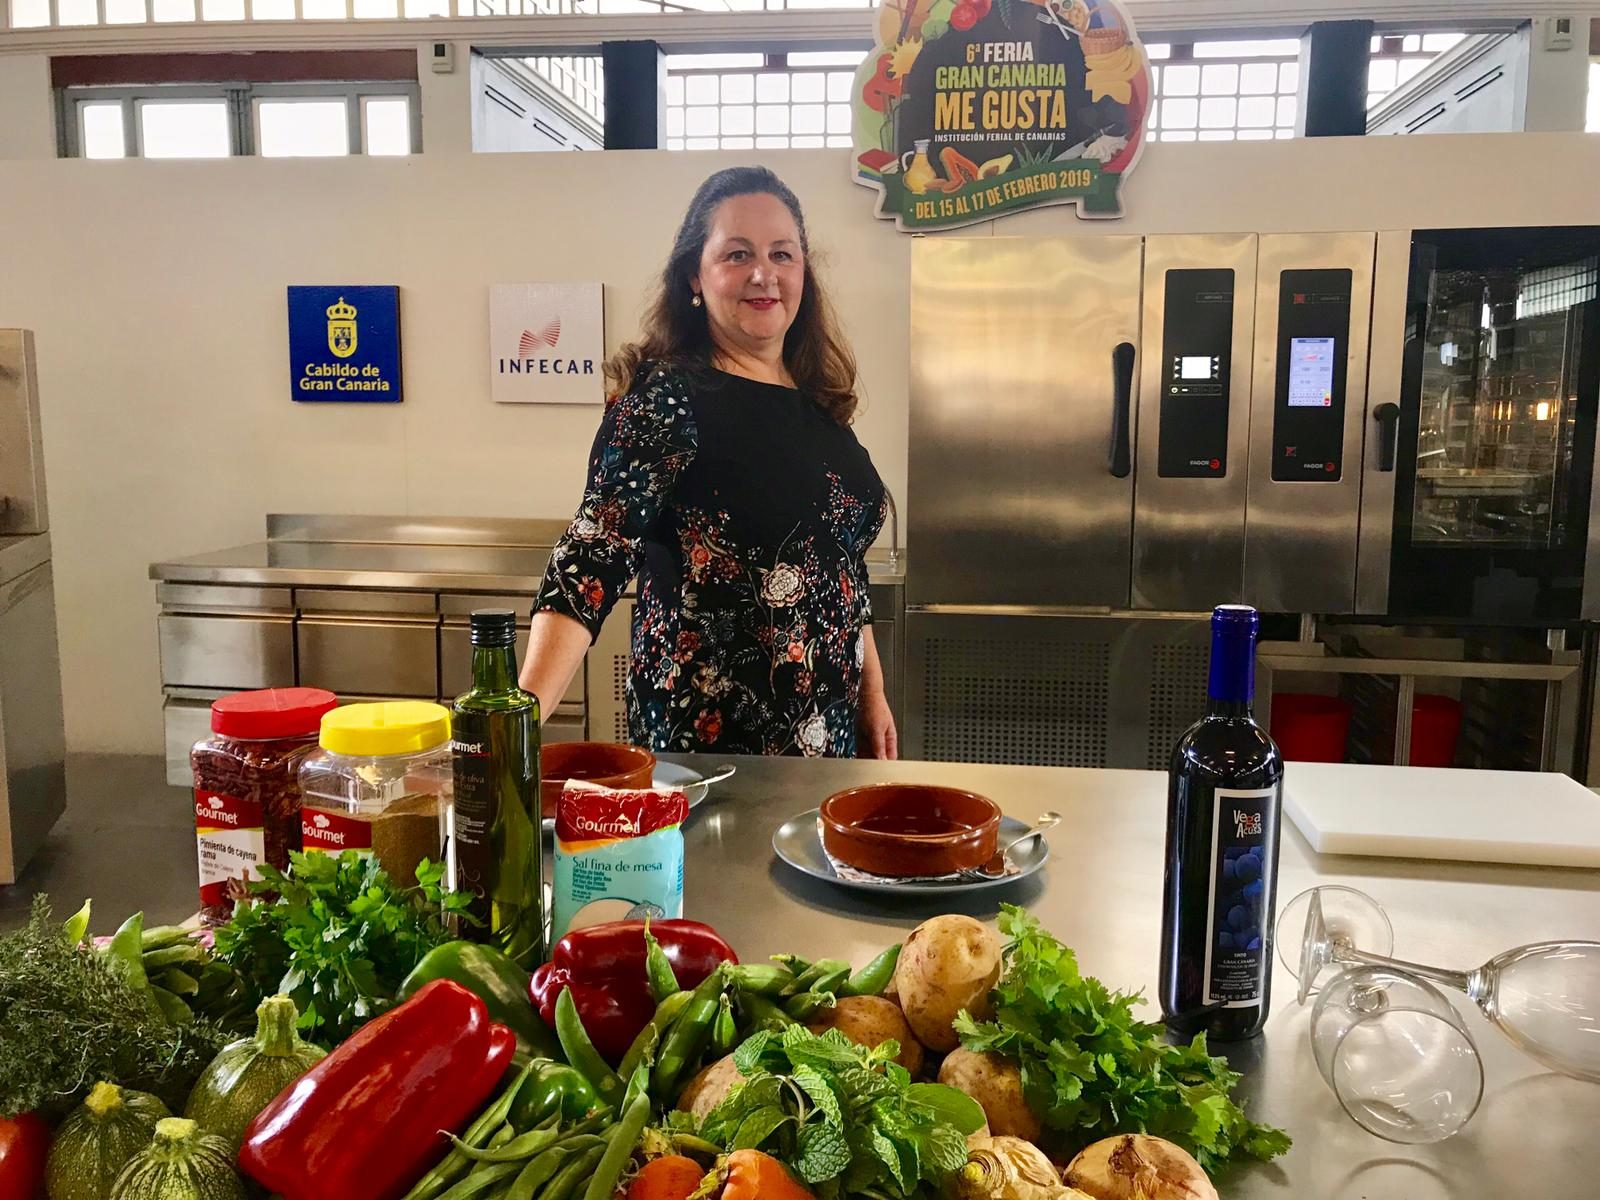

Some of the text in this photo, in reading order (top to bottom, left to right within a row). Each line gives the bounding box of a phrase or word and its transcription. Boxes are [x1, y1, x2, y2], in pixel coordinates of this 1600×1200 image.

[983, 42, 1034, 62] FERIA
[936, 64, 1067, 89] GRAN CANARIA
[934, 89, 1067, 130] ME GUSTA
[934, 132, 1066, 142] INSTITUCIÓN FERIAL DE CANARIAS
[915, 169, 1091, 219] DEL 15 AL 17 DE FEBRERO 2019
[305, 363, 380, 377] Cabildo de
[500, 359, 594, 374] INFECAR
[300, 378, 390, 392] Gran Canaria
[196, 802, 238, 825] Gourmet
[1233, 810, 1261, 828] Vega
[302, 821, 344, 844] Gourmet
[576, 815, 640, 835] Gourmet
[1236, 823, 1262, 838] Acusa
[200, 838, 257, 861] Pimienta de cayena
[200, 850, 217, 860] rama
[572, 856, 588, 869] Sal
[591, 858, 612, 871] fina
[615, 860, 630, 872] de
[634, 862, 663, 872] mesa
